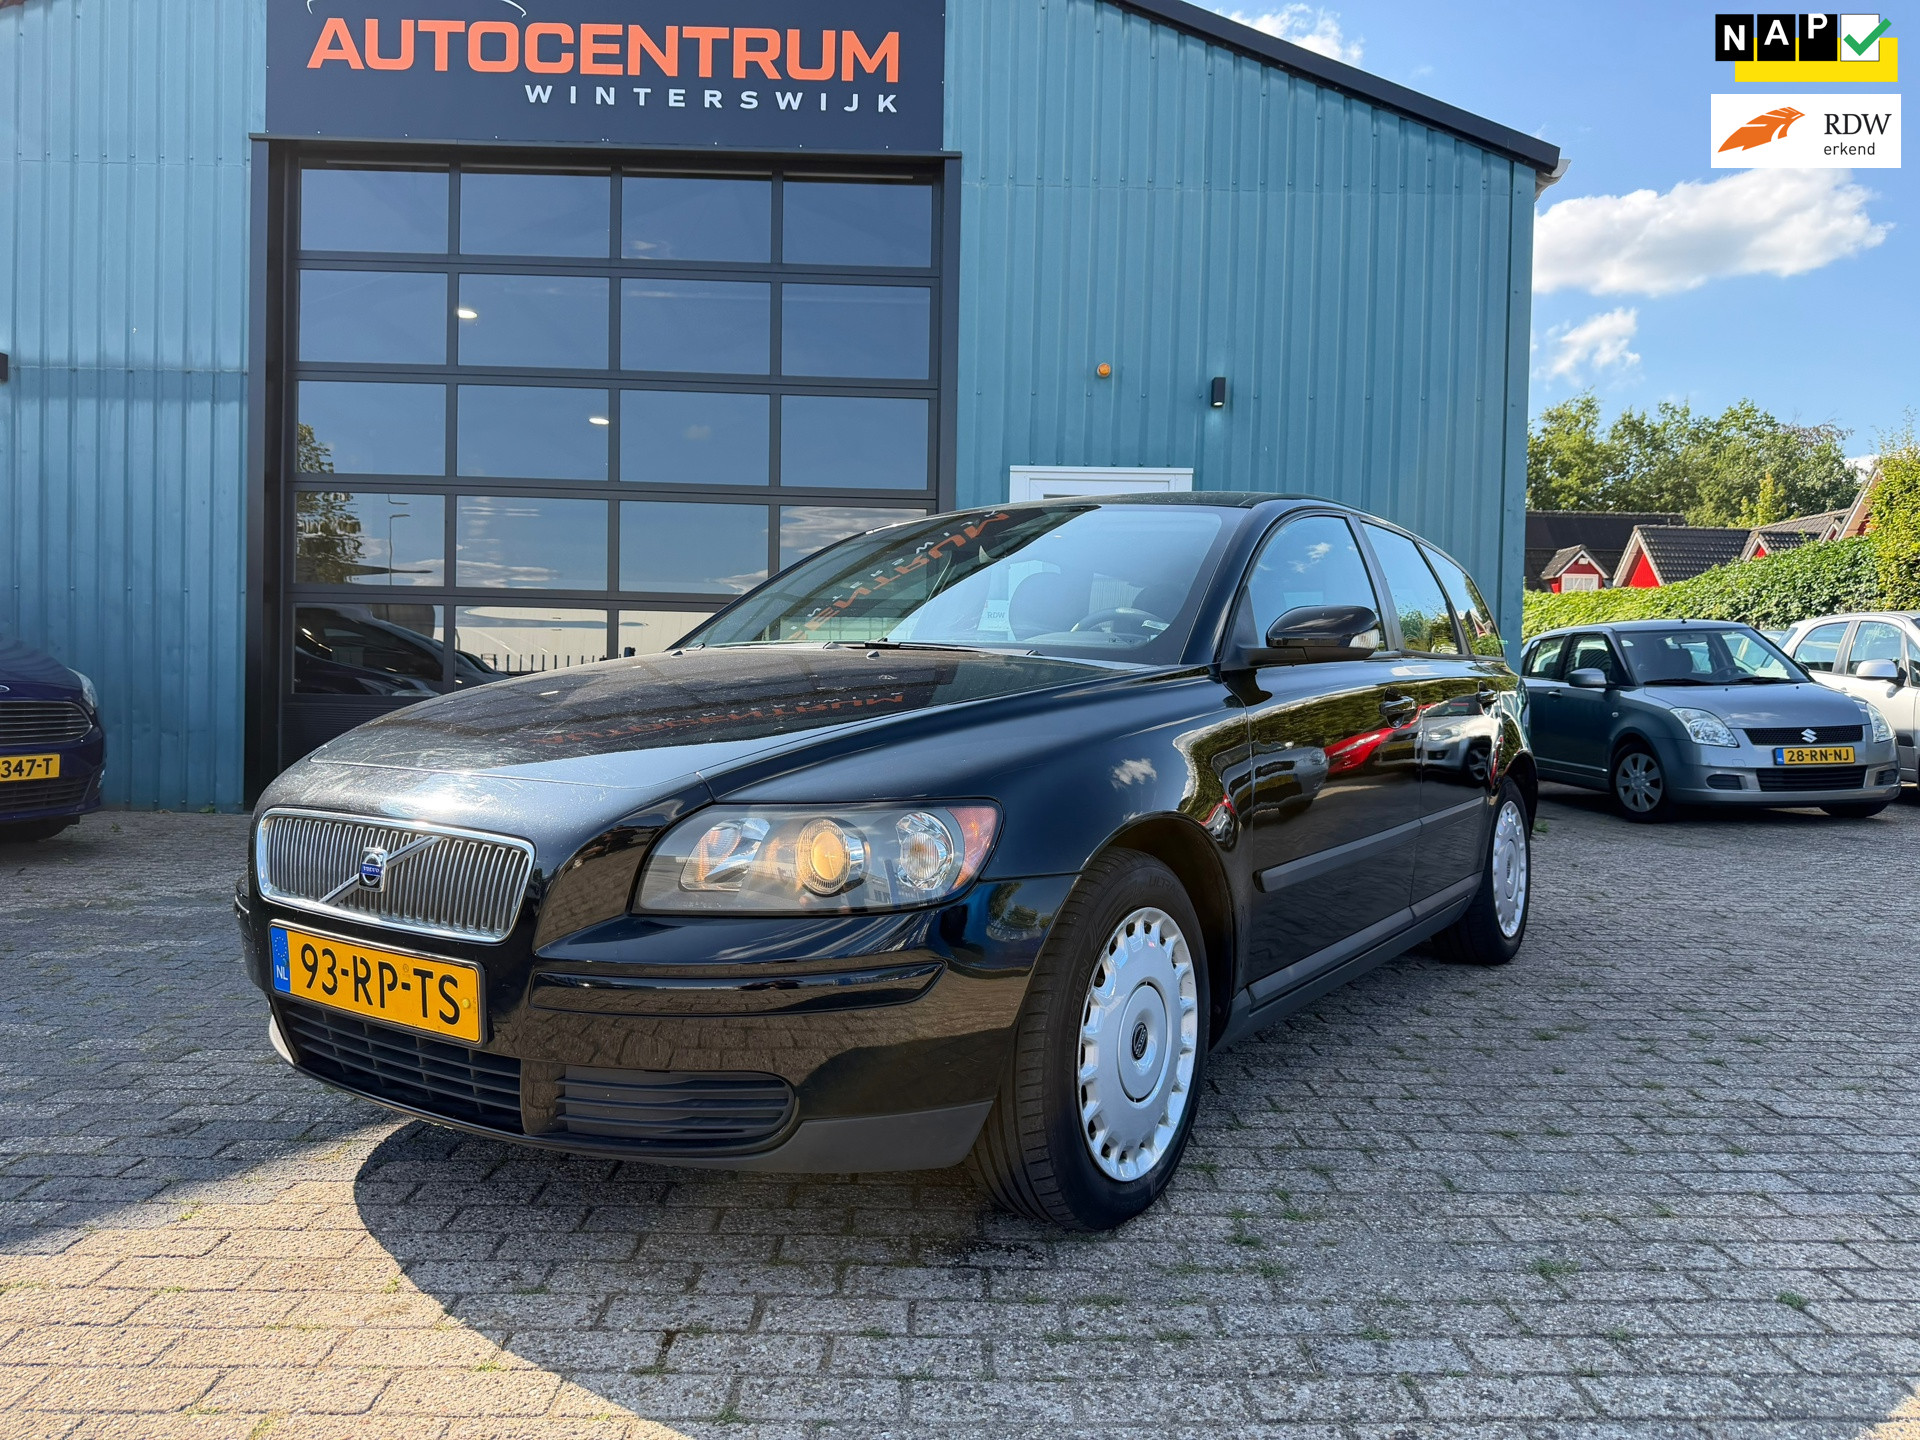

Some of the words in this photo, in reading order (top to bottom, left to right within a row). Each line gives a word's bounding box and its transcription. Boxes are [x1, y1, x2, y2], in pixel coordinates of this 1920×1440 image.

[306, 17, 899, 83] AUTOCENTRUM
[524, 84, 898, 114] WINTERSWIJK
[986, 611, 1006, 619] RDW
[1787, 749, 1850, 762] 28-RN-NJ
[275, 965, 289, 981] NL
[300, 943, 461, 1026] 93-RP-TS
